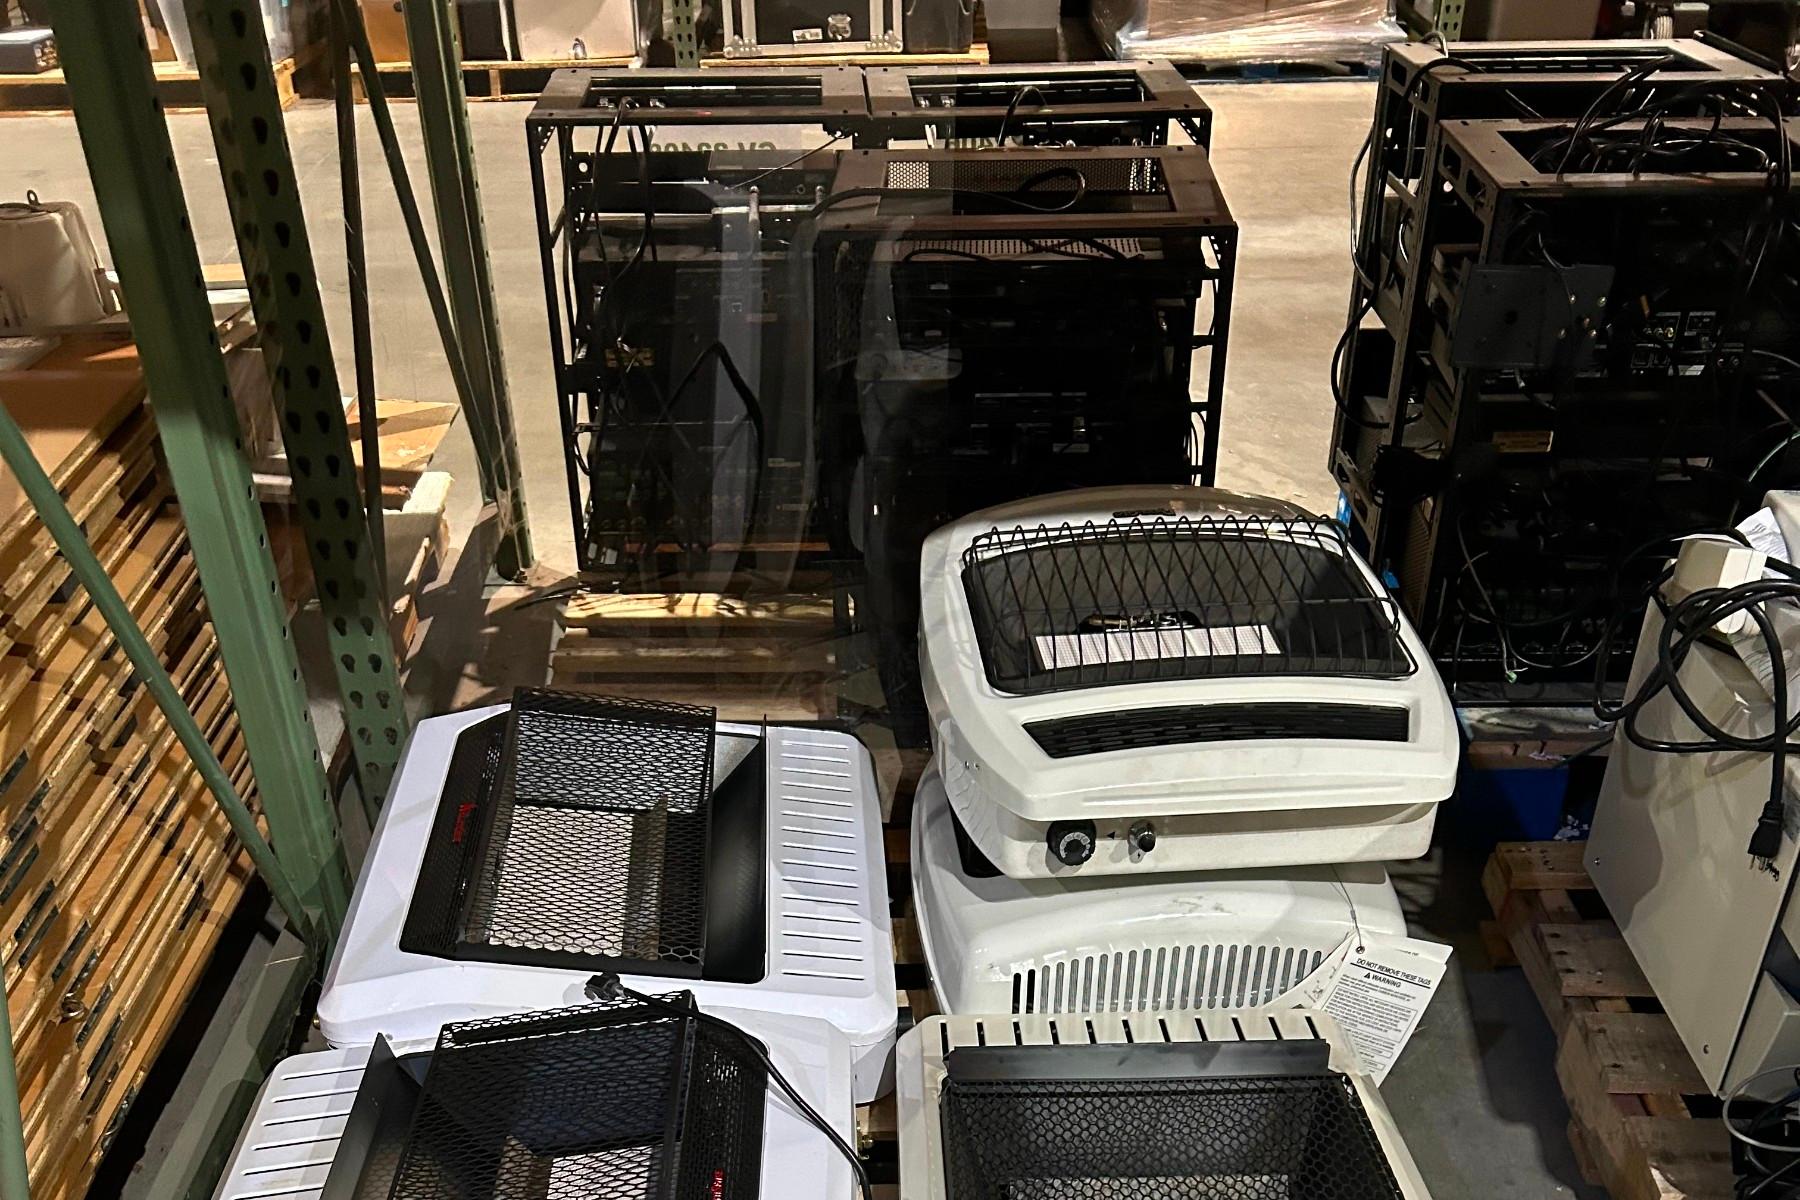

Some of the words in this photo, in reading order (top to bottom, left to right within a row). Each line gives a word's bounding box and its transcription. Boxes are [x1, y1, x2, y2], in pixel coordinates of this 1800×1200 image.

[1366, 960, 1378, 969] NOT
[1377, 964, 1400, 976] REMOVE
[1400, 971, 1418, 981] THESE
[1417, 976, 1432, 986] TAGS
[1371, 974, 1401, 988] WARNING
